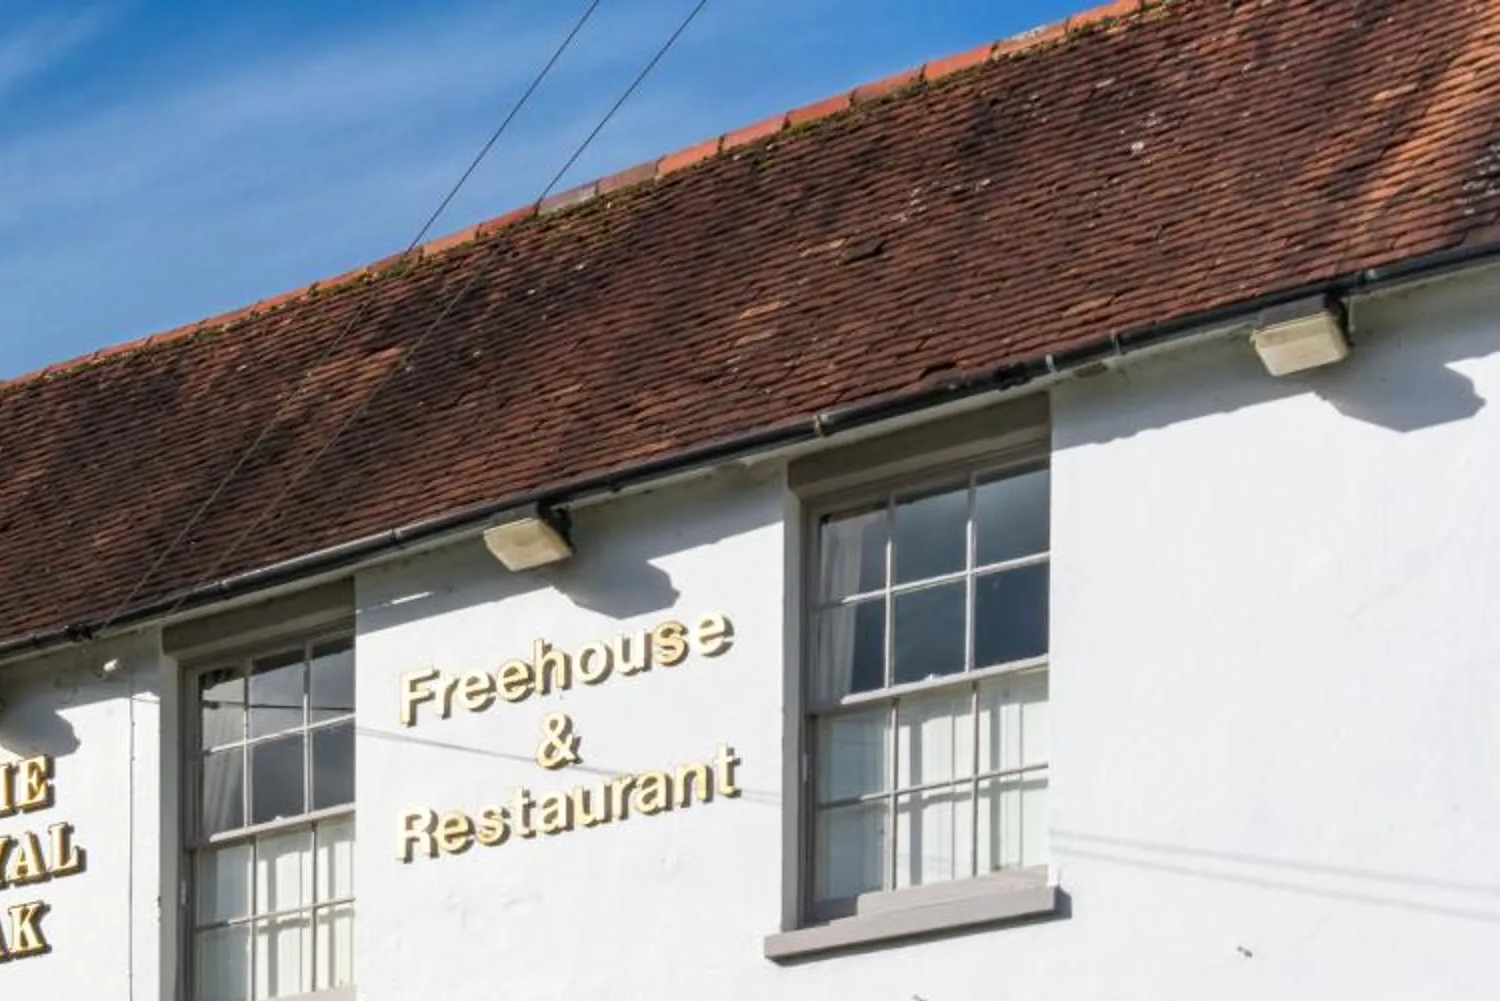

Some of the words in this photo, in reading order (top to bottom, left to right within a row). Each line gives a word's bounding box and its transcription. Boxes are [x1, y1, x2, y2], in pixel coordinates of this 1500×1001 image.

[399, 611, 734, 727] Freehouse
[535, 711, 583, 770] &
[397, 742, 741, 862] Restaurant
